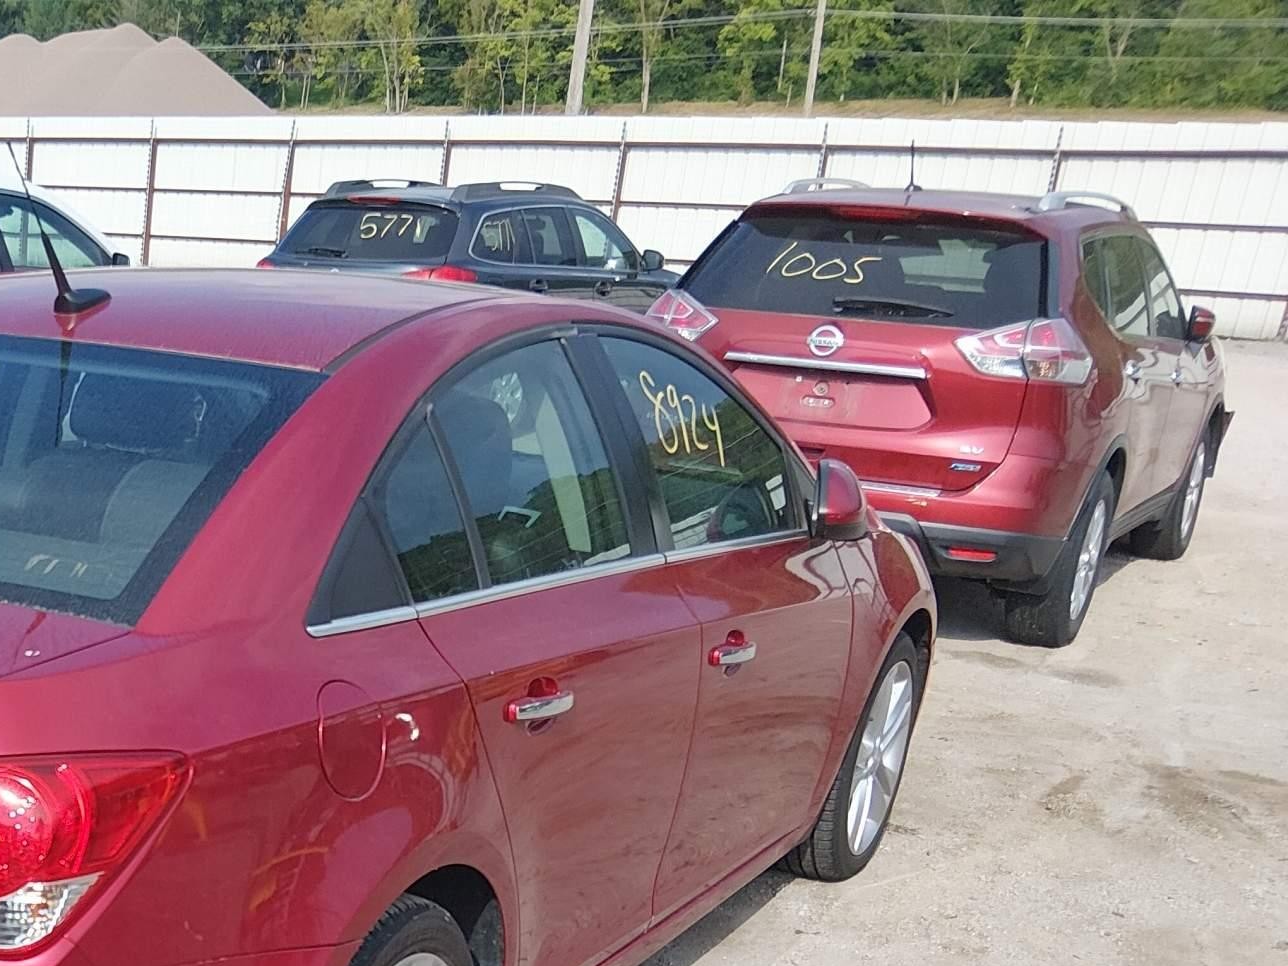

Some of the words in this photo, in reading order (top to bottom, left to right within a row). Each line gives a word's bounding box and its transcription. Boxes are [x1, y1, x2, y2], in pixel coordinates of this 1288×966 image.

[360, 212, 422, 239] 5771
[765, 241, 883, 284] 1005
[639, 370, 726, 468] 8924
